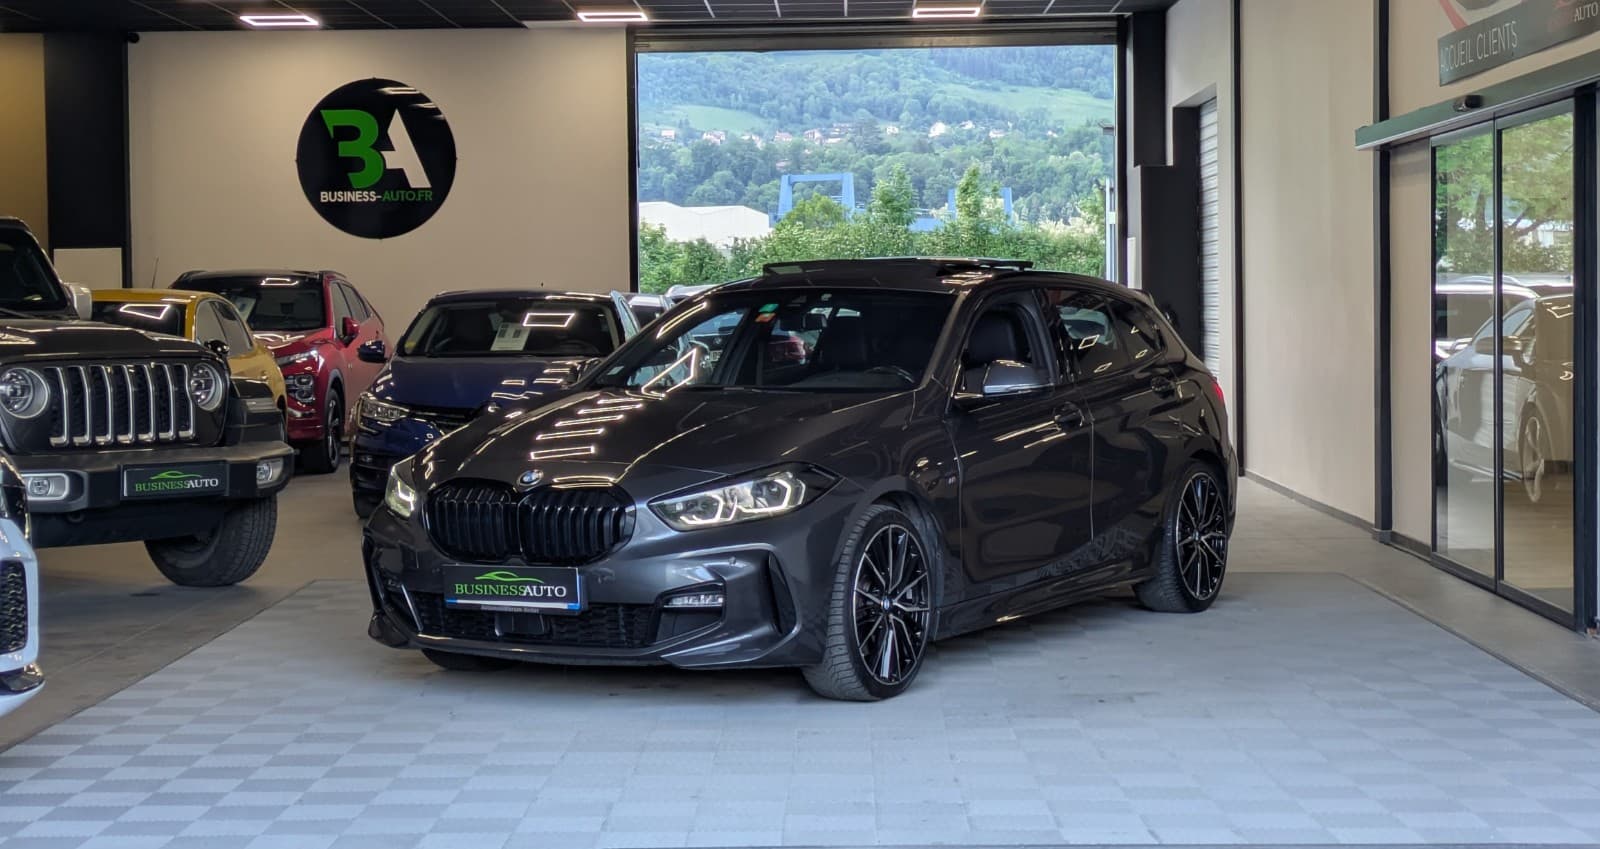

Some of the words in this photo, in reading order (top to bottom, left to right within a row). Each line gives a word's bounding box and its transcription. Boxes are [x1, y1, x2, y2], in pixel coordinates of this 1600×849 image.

[1574, 2, 1599, 23] AUTO
[1440, 39, 1474, 73] ACCUEIL
[1476, 20, 1518, 60] CLIENTS
